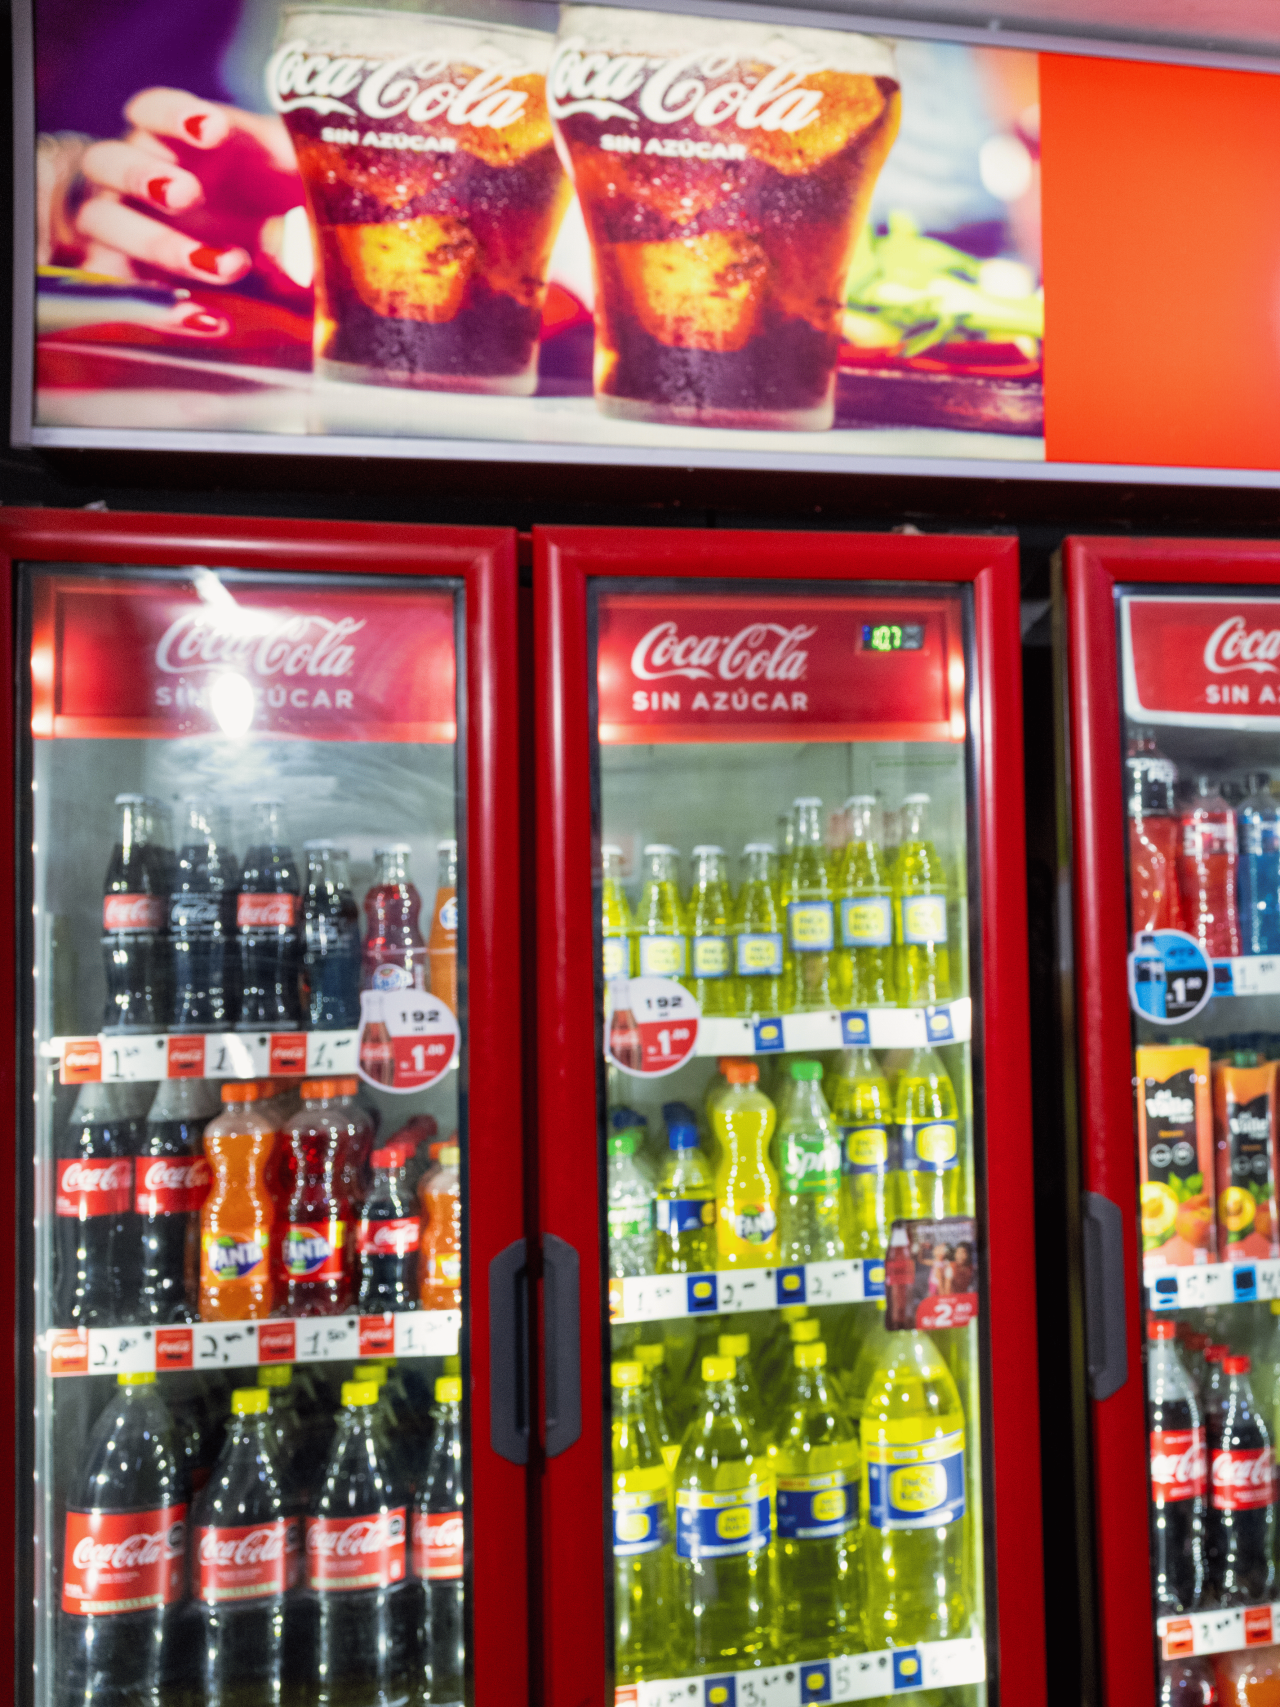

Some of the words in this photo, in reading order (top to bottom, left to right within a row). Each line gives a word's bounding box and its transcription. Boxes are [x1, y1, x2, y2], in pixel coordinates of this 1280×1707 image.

[321, 127, 360, 146] SIN
[600, 133, 642, 154] SIN
[631, 620, 818, 682] Coca-Cola
[632, 690, 681, 712] SIN
[691, 687, 809, 712] AZÚCAR
[1205, 684, 1250, 705] SIN
[646, 995, 683, 1009] 192
[400, 1009, 440, 1024] 192
